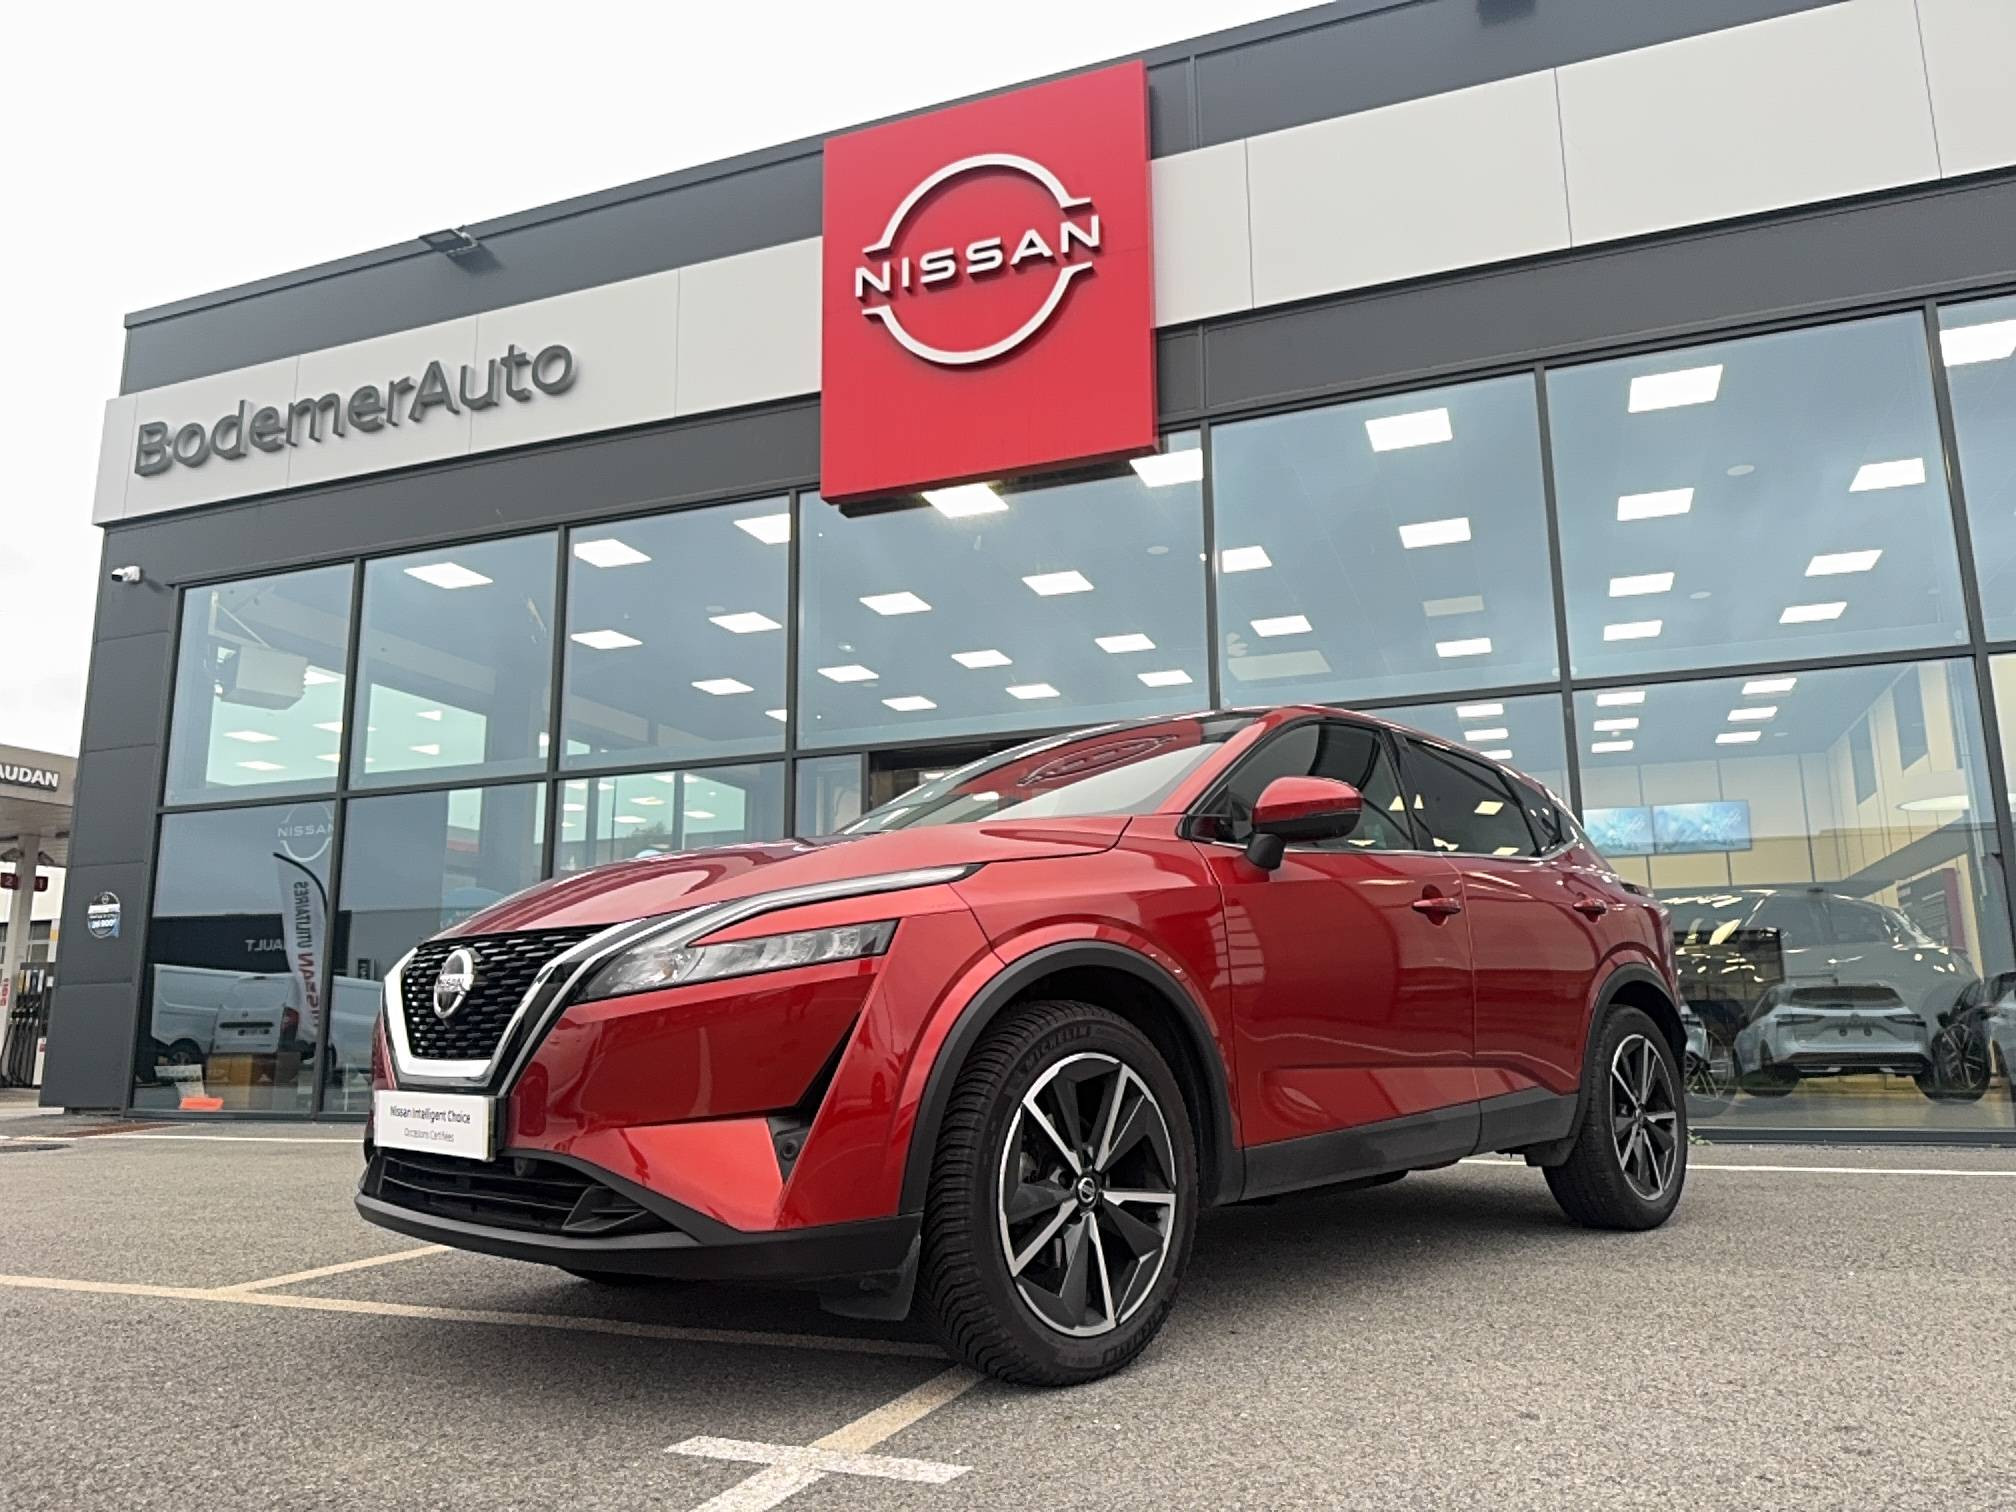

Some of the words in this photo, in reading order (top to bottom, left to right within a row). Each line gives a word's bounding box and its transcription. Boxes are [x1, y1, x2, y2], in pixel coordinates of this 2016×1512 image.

[855, 215, 1100, 298] NISSAN
[134, 343, 575, 477] BodemerAuto
[390, 1105, 411, 1118] Nissan
[412, 1107, 446, 1123] Intelligent
[447, 1110, 471, 1124] Choice
